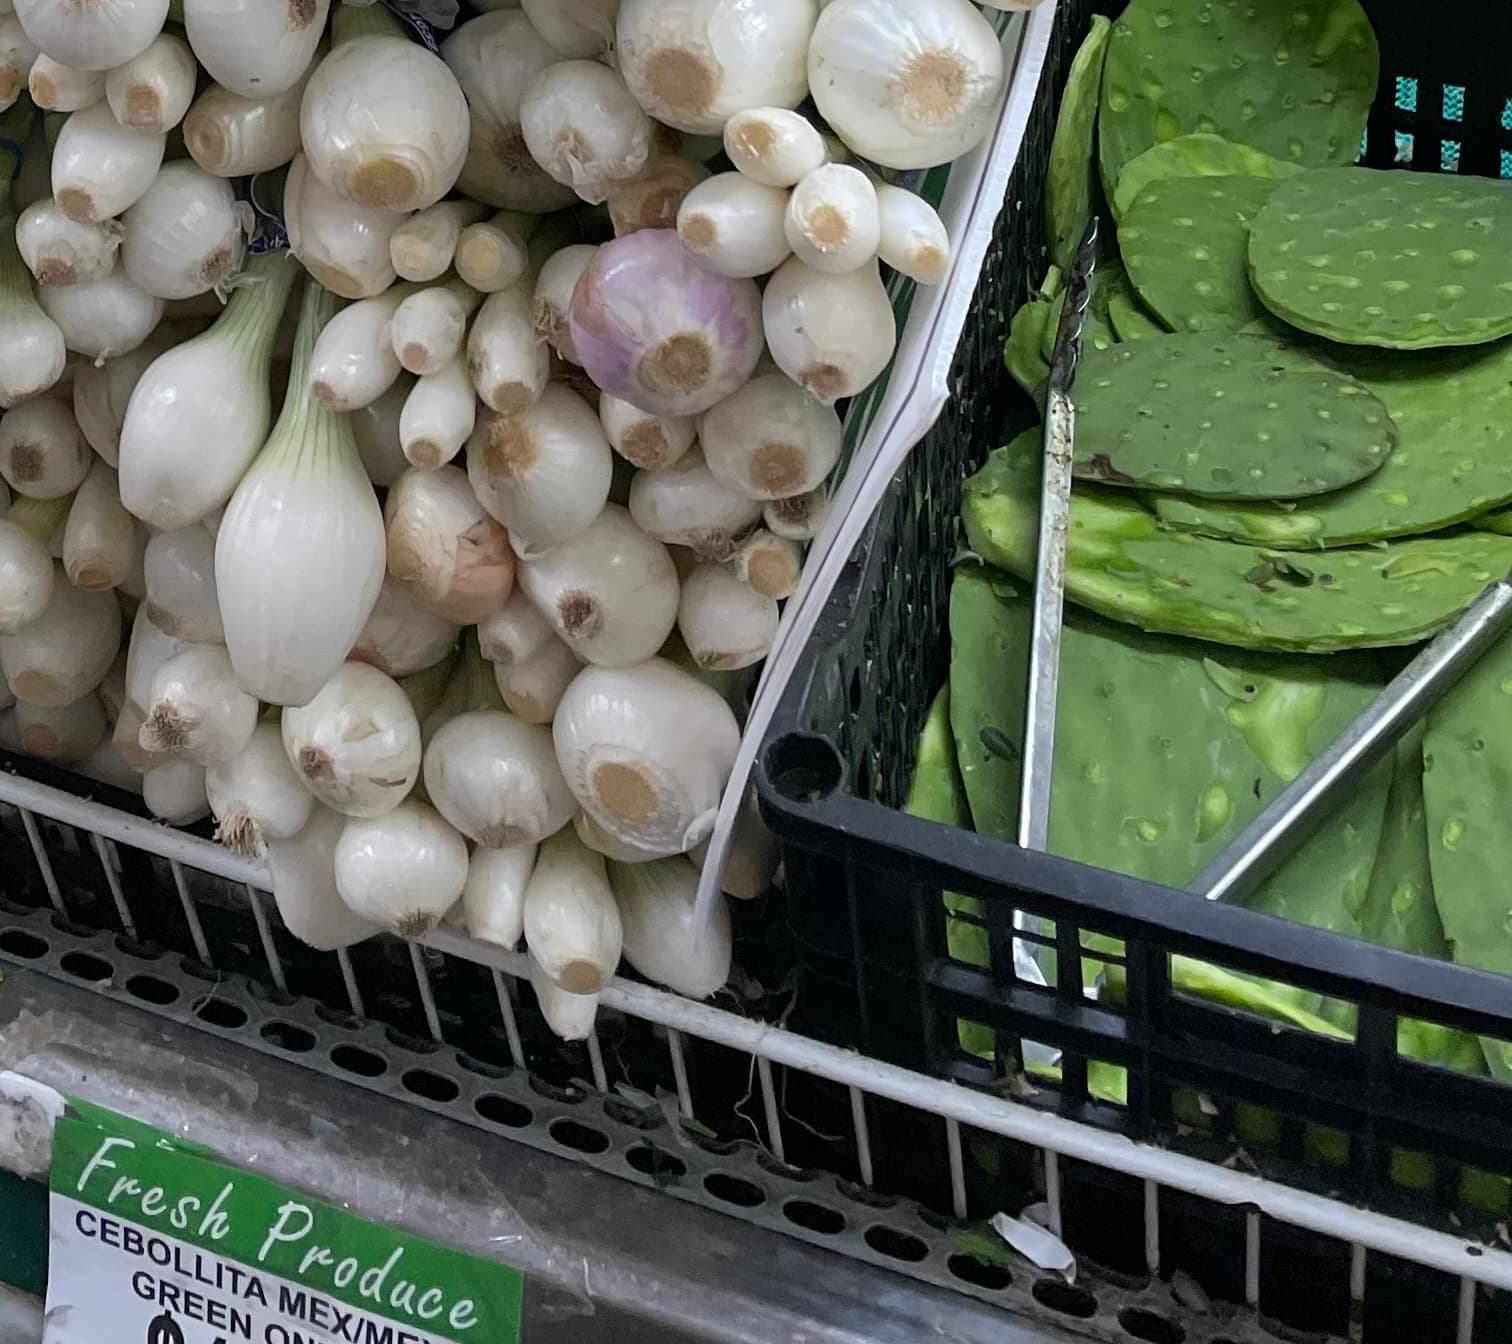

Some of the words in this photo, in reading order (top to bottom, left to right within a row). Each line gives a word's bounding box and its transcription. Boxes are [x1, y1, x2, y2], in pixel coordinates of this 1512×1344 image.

[75, 1208, 268, 1308] CEBOLLITA
[76, 1136, 234, 1241] Fresh
[257, 1199, 479, 1330] Produce
[131, 1271, 252, 1340] GREEN
